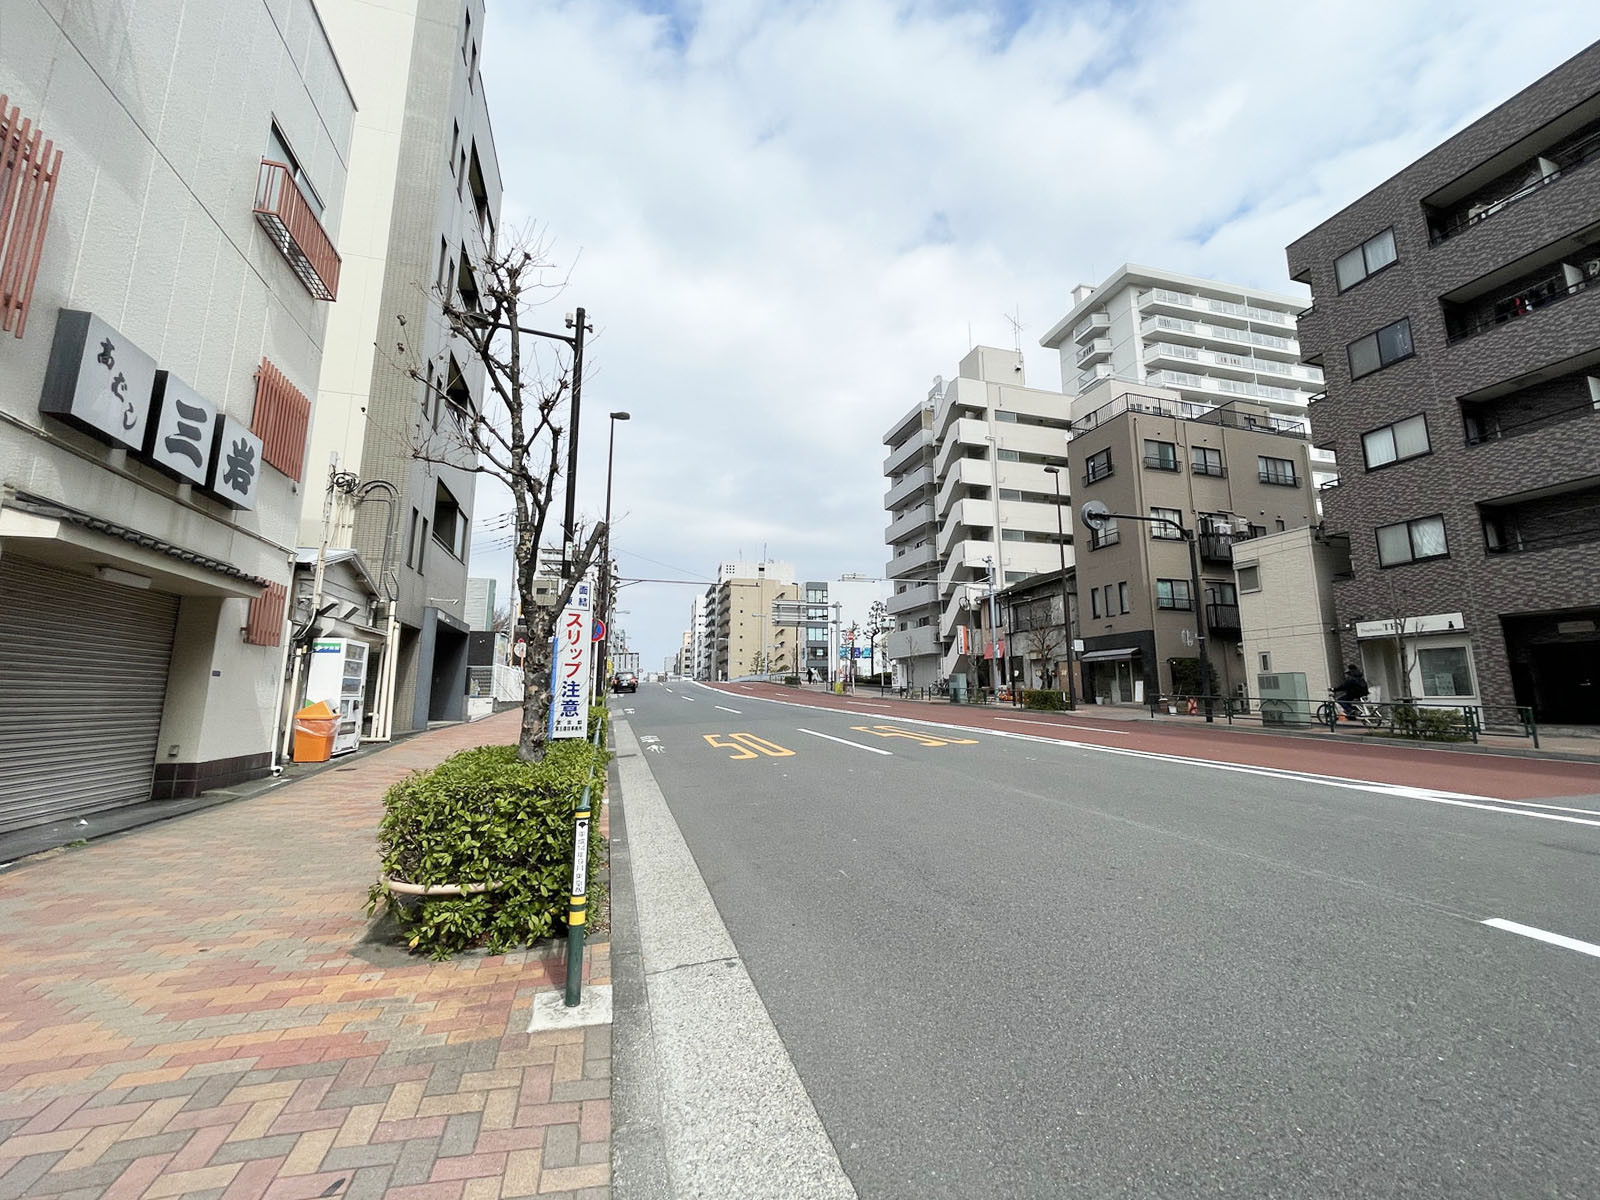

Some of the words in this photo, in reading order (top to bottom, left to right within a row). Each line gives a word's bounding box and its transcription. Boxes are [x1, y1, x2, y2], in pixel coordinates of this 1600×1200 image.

[560, 613, 583, 718] スリップ注意
[702, 732, 796, 760] 50
